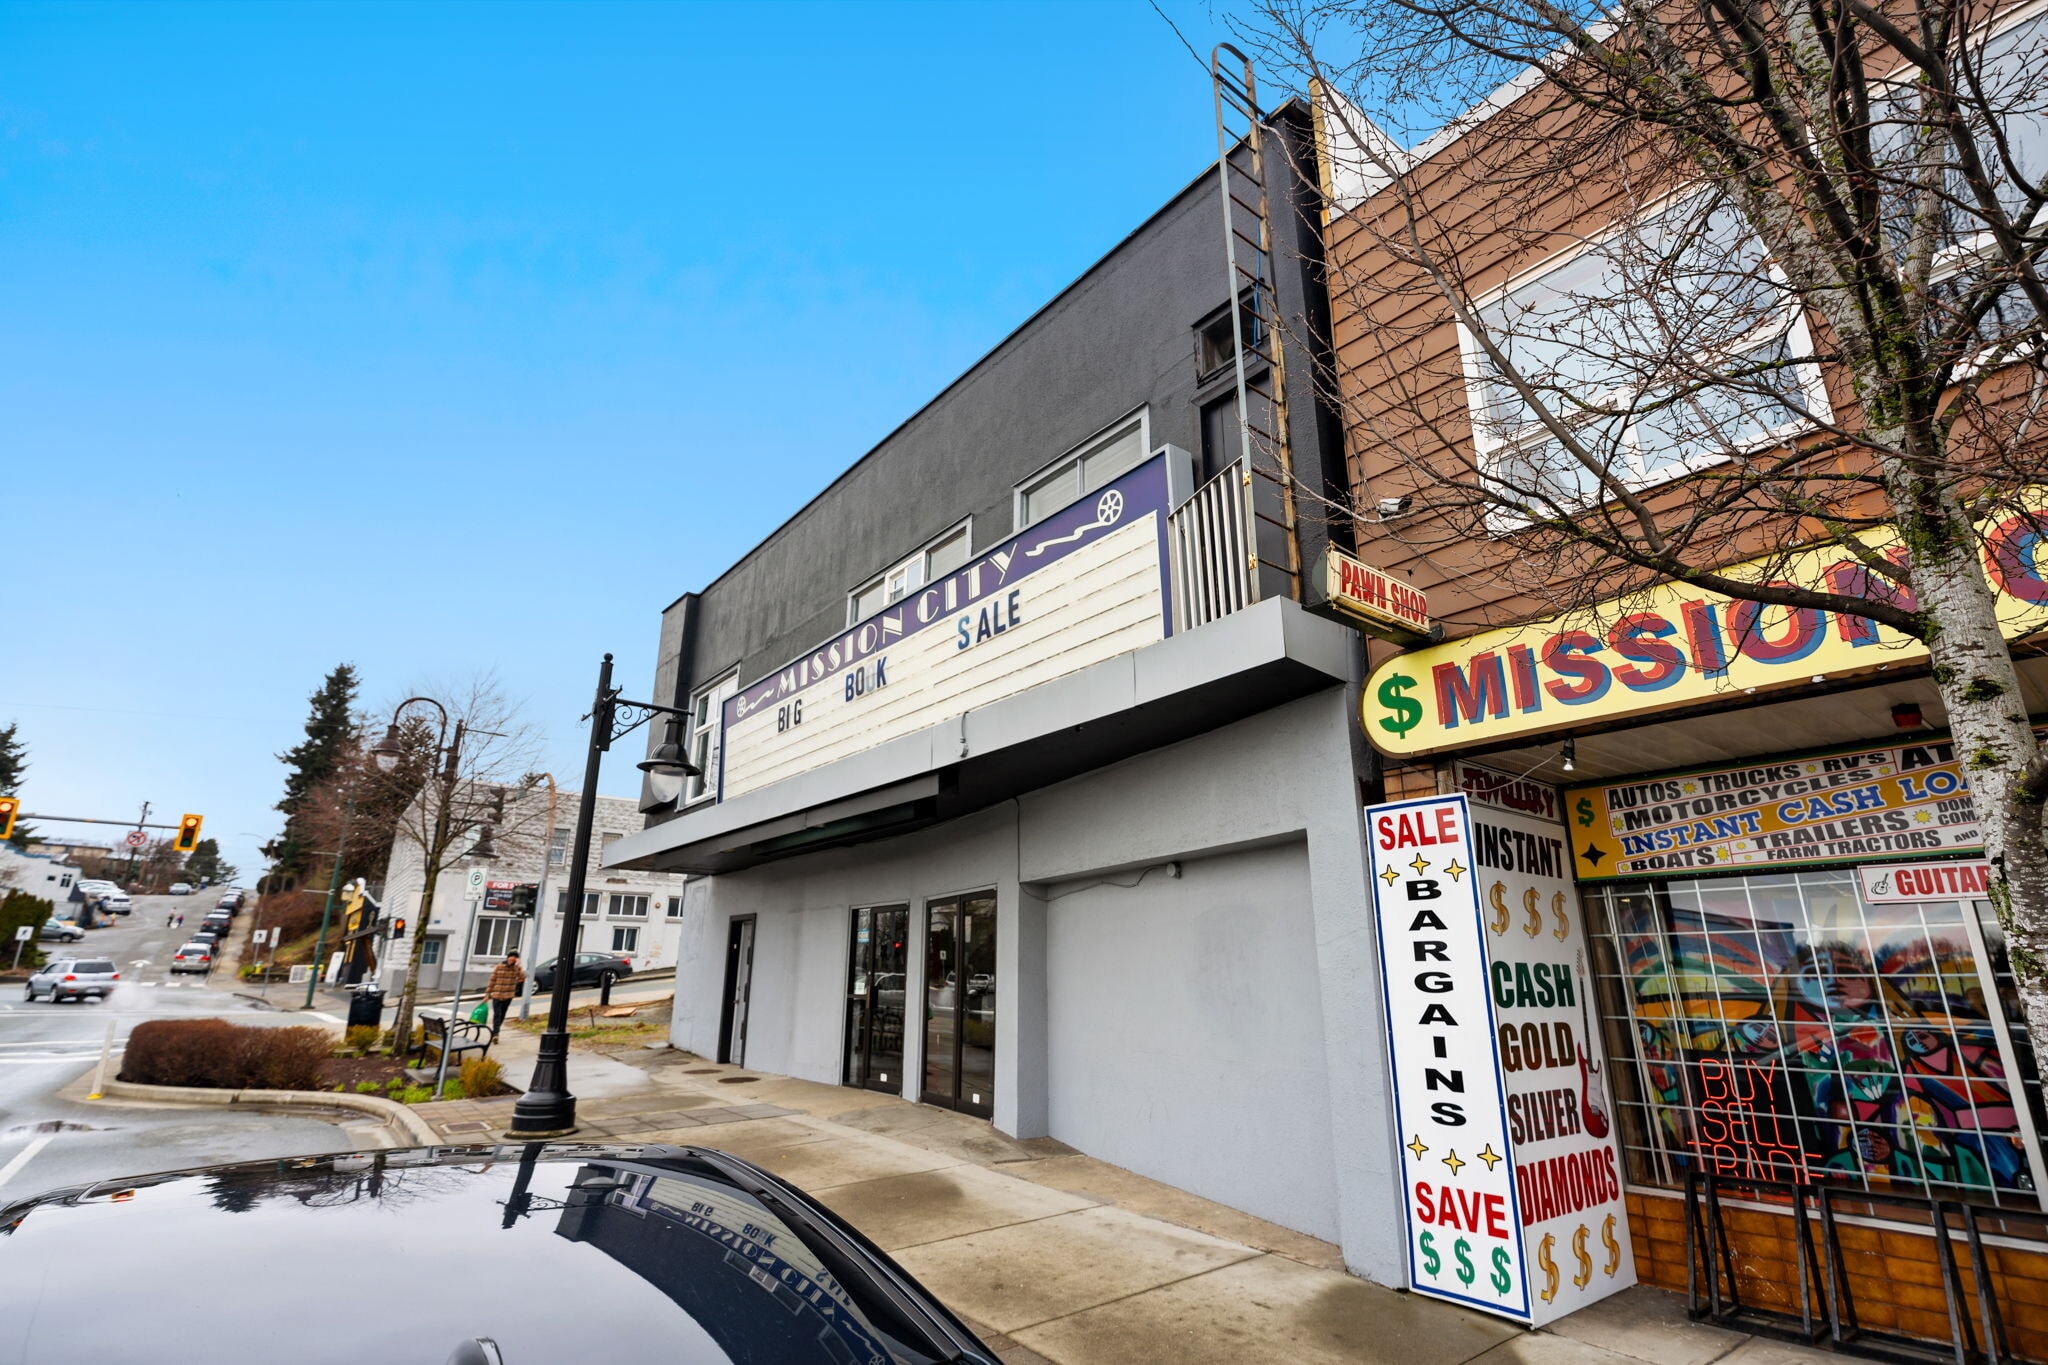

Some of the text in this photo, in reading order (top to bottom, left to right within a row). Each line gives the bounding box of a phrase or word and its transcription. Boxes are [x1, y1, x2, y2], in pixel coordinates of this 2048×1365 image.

[777, 542, 1018, 697] MISSION CITY
[1341, 559, 1427, 626] PAWN SHOP
[777, 589, 1021, 733] BIG BOOK SALE
[1431, 545, 1919, 730] MISSION
[1608, 752, 1887, 811] AUTOS TRUCKS RV'S
[1625, 769, 1874, 832] MOTORCYCLES
[1377, 807, 1459, 851] SALE
[1620, 810, 1761, 857] INSTANT
[1778, 784, 1885, 825] CASH
[1631, 809, 1910, 871] BOATS TRAILERS
[1767, 829, 1979, 861] FARM TRACTORS AND
[1475, 822, 1563, 880] INSTANT
[1406, 879, 1467, 1127] BARGAINS
[1493, 960, 1576, 1008] CASH
[1500, 1021, 1576, 1073] GOLD
[1699, 1058, 1776, 1101] BUY
[1509, 1087, 1581, 1145] SILVER
[1701, 1099, 1799, 1149] SELL
[1415, 1180, 1509, 1240] SAVE
[1517, 1145, 1619, 1227] DIAMONDS
